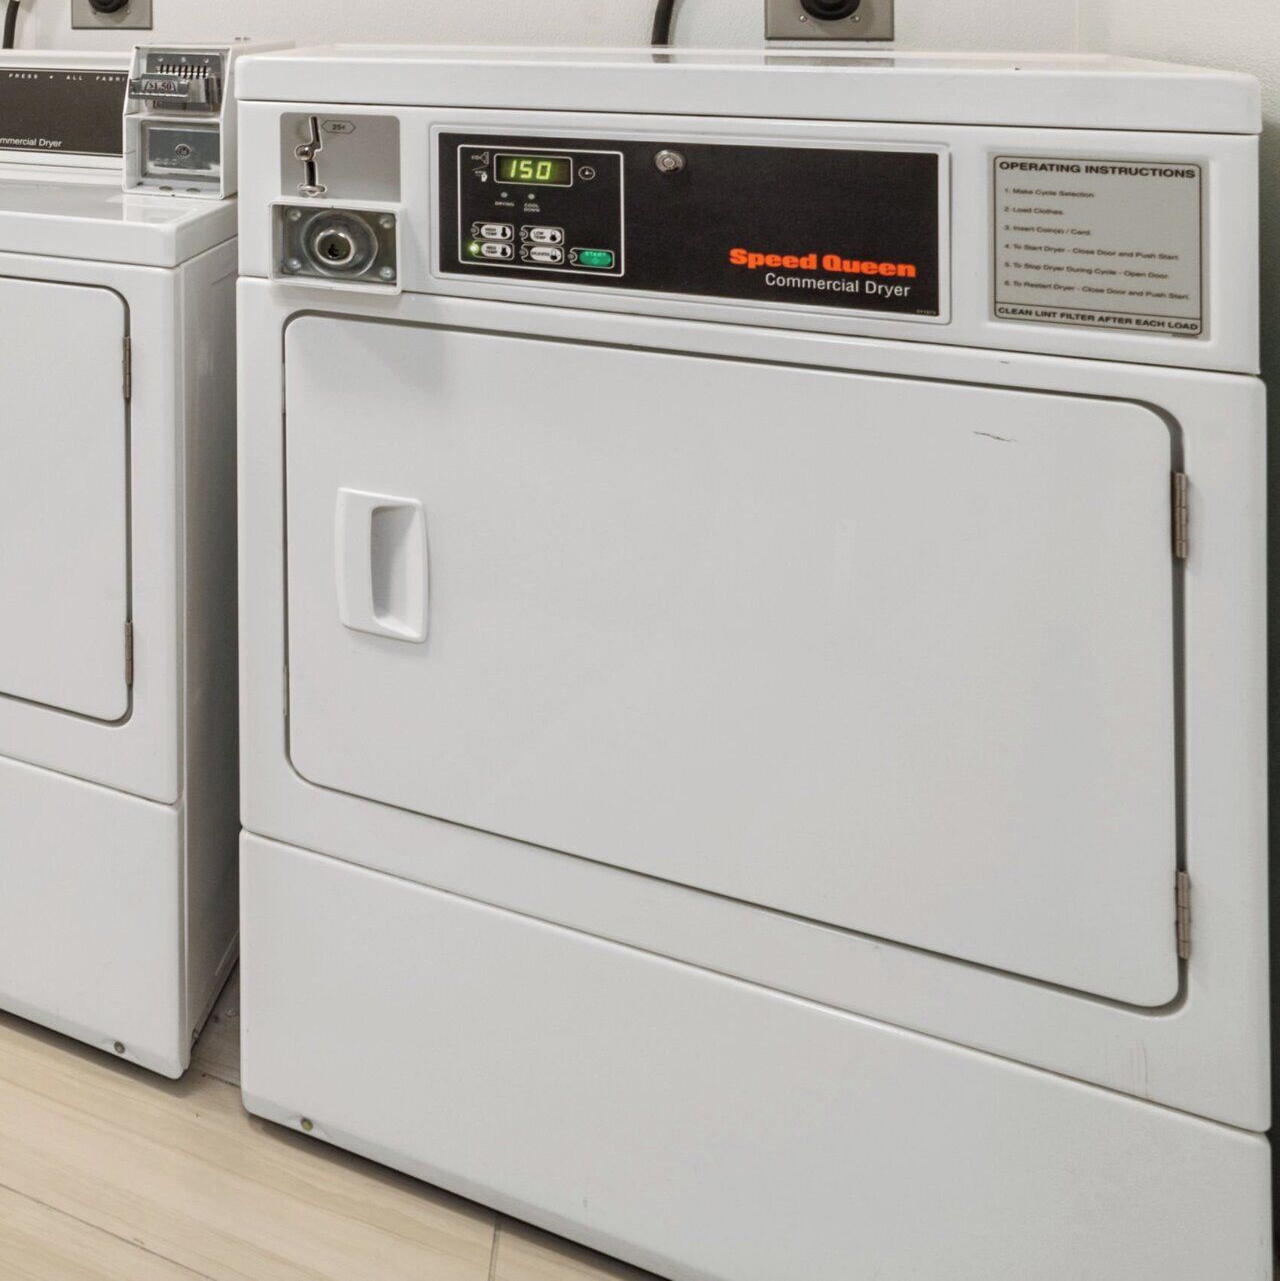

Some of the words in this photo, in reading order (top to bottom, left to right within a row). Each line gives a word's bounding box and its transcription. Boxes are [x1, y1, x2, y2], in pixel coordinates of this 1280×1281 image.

[38, 137, 62, 148] Dryer
[509, 159, 552, 180] 150
[999, 161, 1081, 174] OPERATING
[1084, 165, 1197, 179] INSTRUCTIONS
[1043, 246, 1065, 254] Dryer
[1072, 247, 1095, 255] Close
[1135, 251, 1157, 259] Push
[728, 247, 818, 270] Speed
[821, 253, 917, 278] Queen
[1043, 264, 1065, 272] Dryer
[1066, 266, 1093, 275] During
[1093, 268, 1117, 276] Cycle
[1123, 270, 1146, 278] Open
[765, 272, 859, 293] Commercial
[865, 280, 911, 299] Dryer
[1023, 281, 1052, 289] Restart
[1081, 285, 1105, 294] Close
[1106, 287, 1127, 295] Door
[998, 307, 1033, 318] CLEAN
[1034, 310, 1058, 318] LINT
[1060, 312, 1095, 322] FILTER
[1098, 315, 1133, 325] AFTER
[1135, 318, 1165, 328] EACH
[1167, 321, 1199, 331] LOAD
